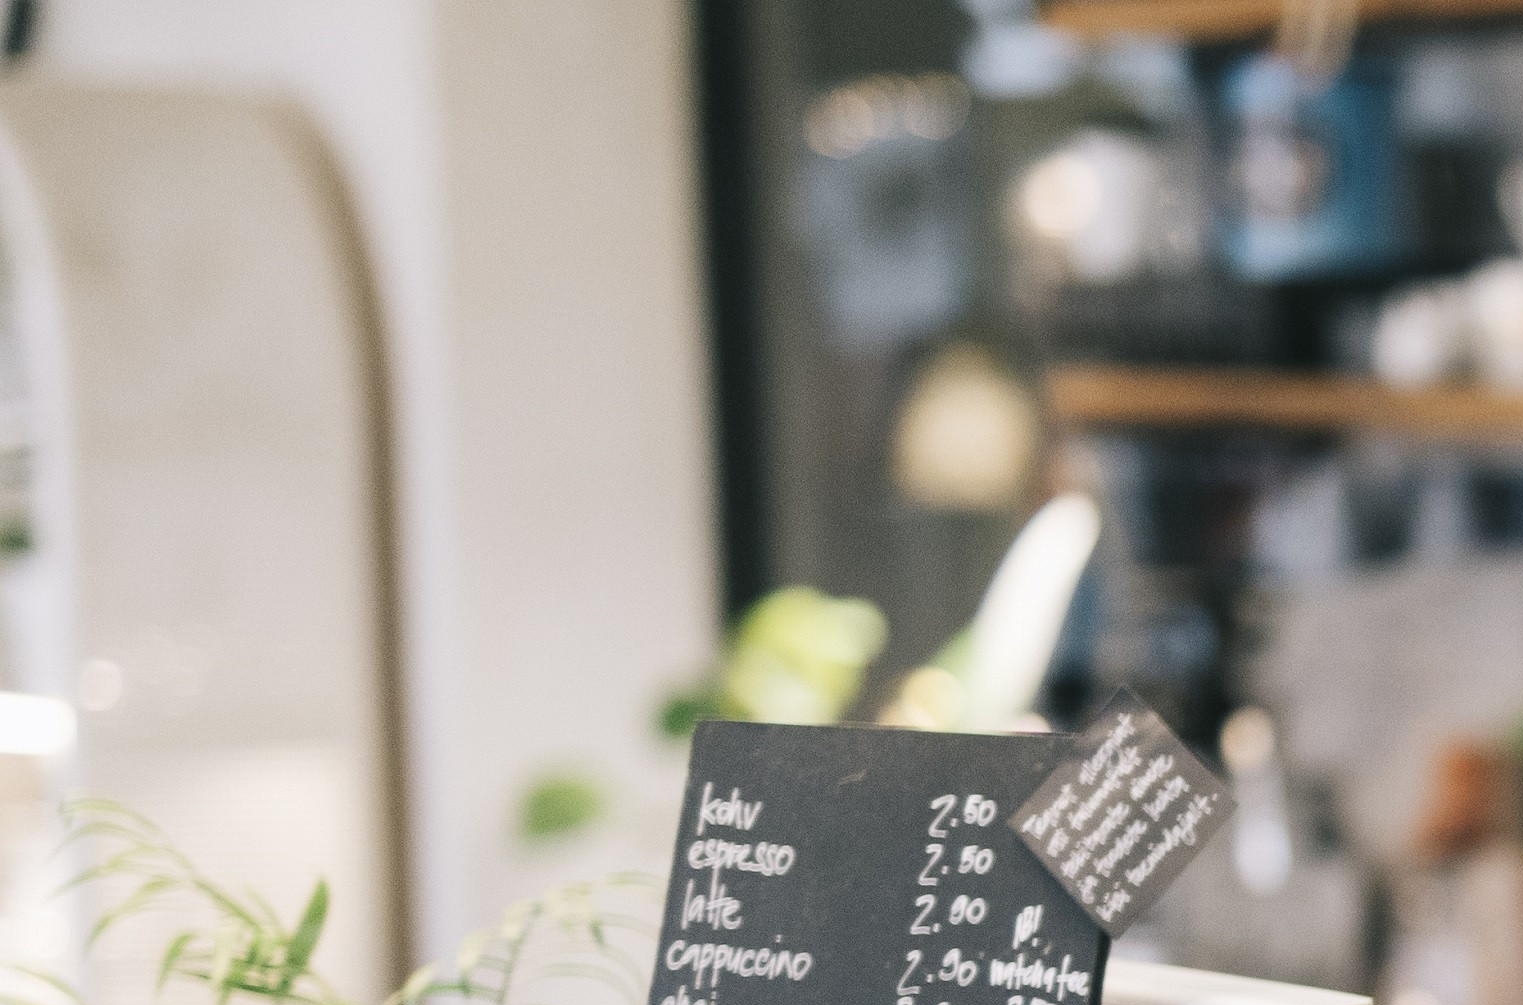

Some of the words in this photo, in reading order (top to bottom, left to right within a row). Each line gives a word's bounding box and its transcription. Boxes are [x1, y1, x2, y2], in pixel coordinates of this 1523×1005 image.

[697, 782, 763, 836] kohv
[928, 794, 997, 838] 2.50
[688, 838, 796, 886] espresso
[917, 843, 993, 886] 2.50
[681, 878, 742, 930] latte
[666, 933, 813, 990] cappuccino
[896, 947, 978, 995] 2.90
